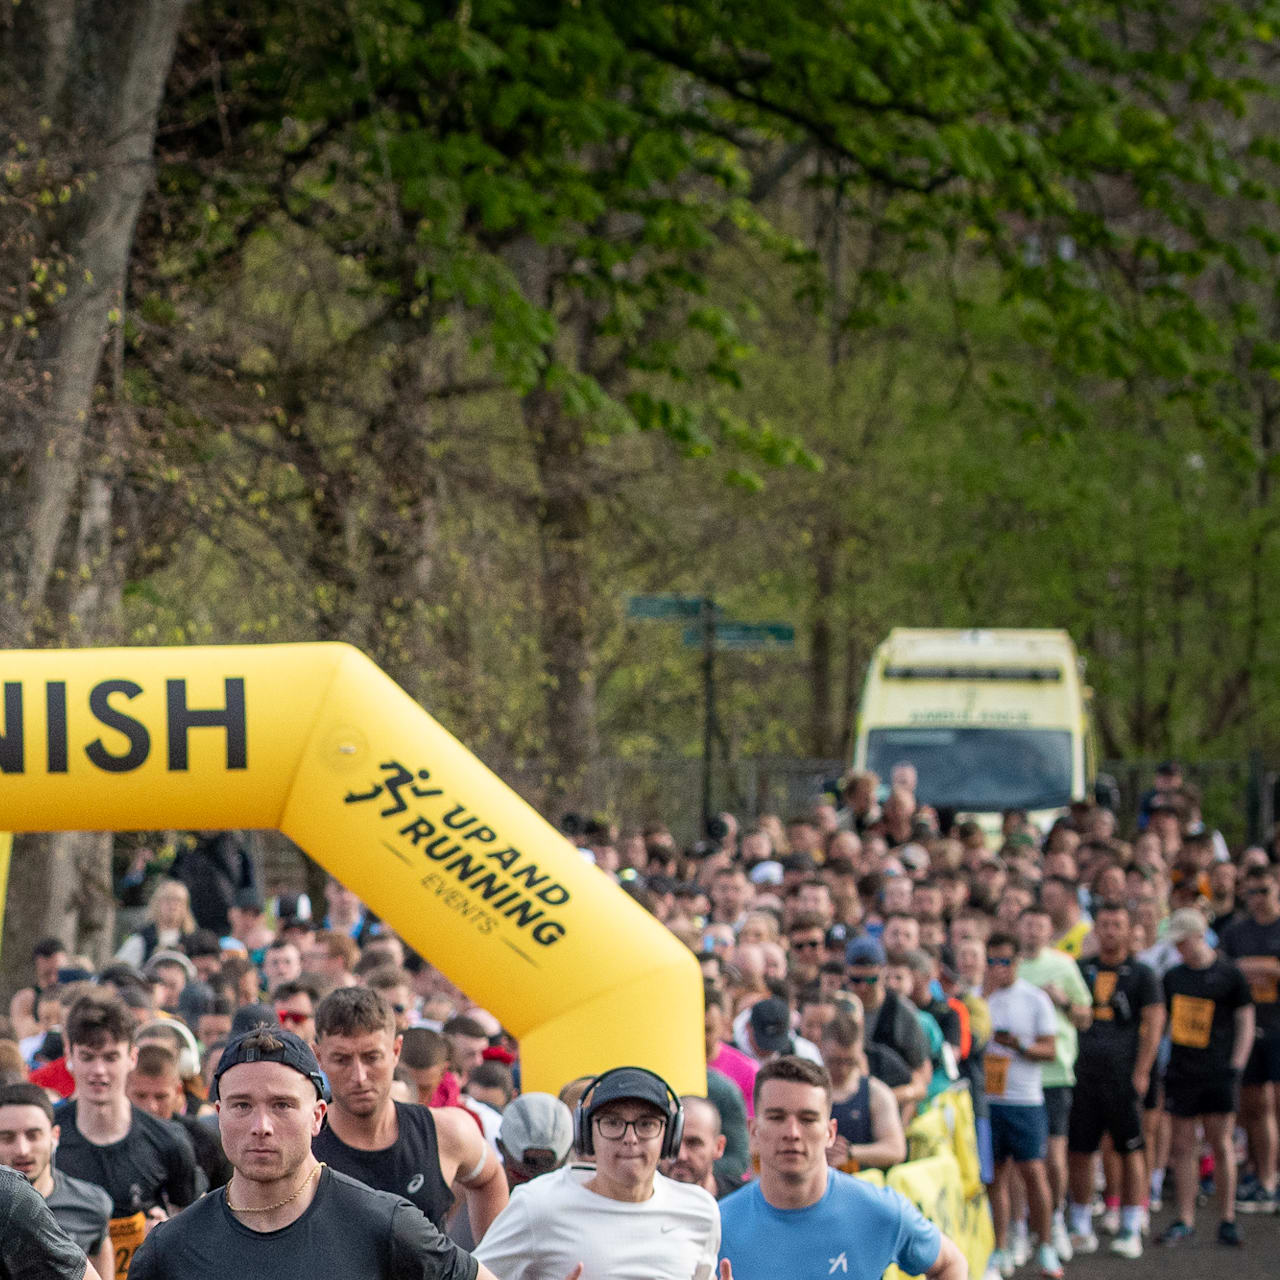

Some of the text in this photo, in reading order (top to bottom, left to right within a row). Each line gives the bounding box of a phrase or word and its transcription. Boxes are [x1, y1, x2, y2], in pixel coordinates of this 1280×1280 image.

[399, 814, 566, 947] RUNNING
[421, 872, 499, 935] EVENTS
[442, 802, 570, 906] UP AND
